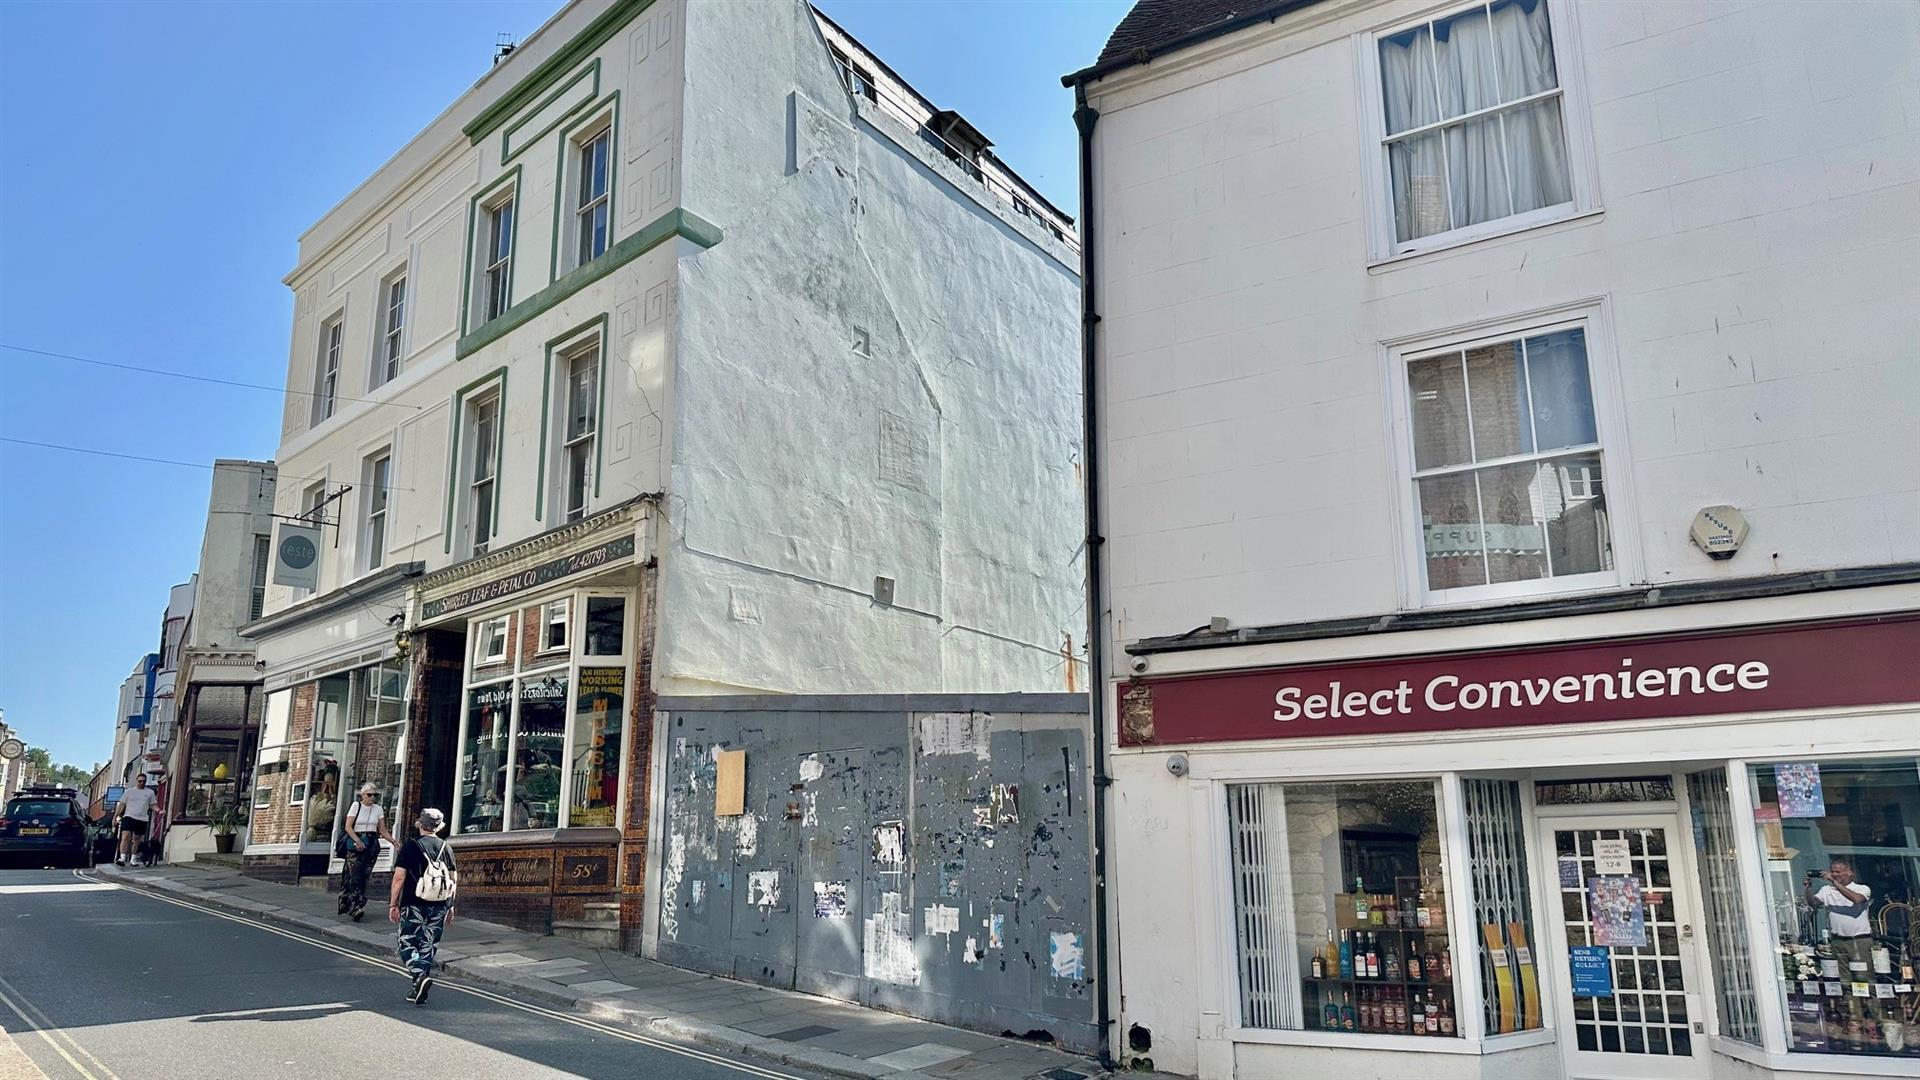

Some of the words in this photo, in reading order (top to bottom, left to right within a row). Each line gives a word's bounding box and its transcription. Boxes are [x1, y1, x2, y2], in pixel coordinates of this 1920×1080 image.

[441, 592, 469, 612] SHIRLEY
[471, 586, 490, 602] LEAF
[490, 583, 498, 597] &
[498, 576, 522, 595] PETAL
[524, 571, 536, 586] CO
[580, 676, 624, 686] WORKING
[1273, 680, 1413, 721] Select
[1425, 658, 1769, 712] Convenience
